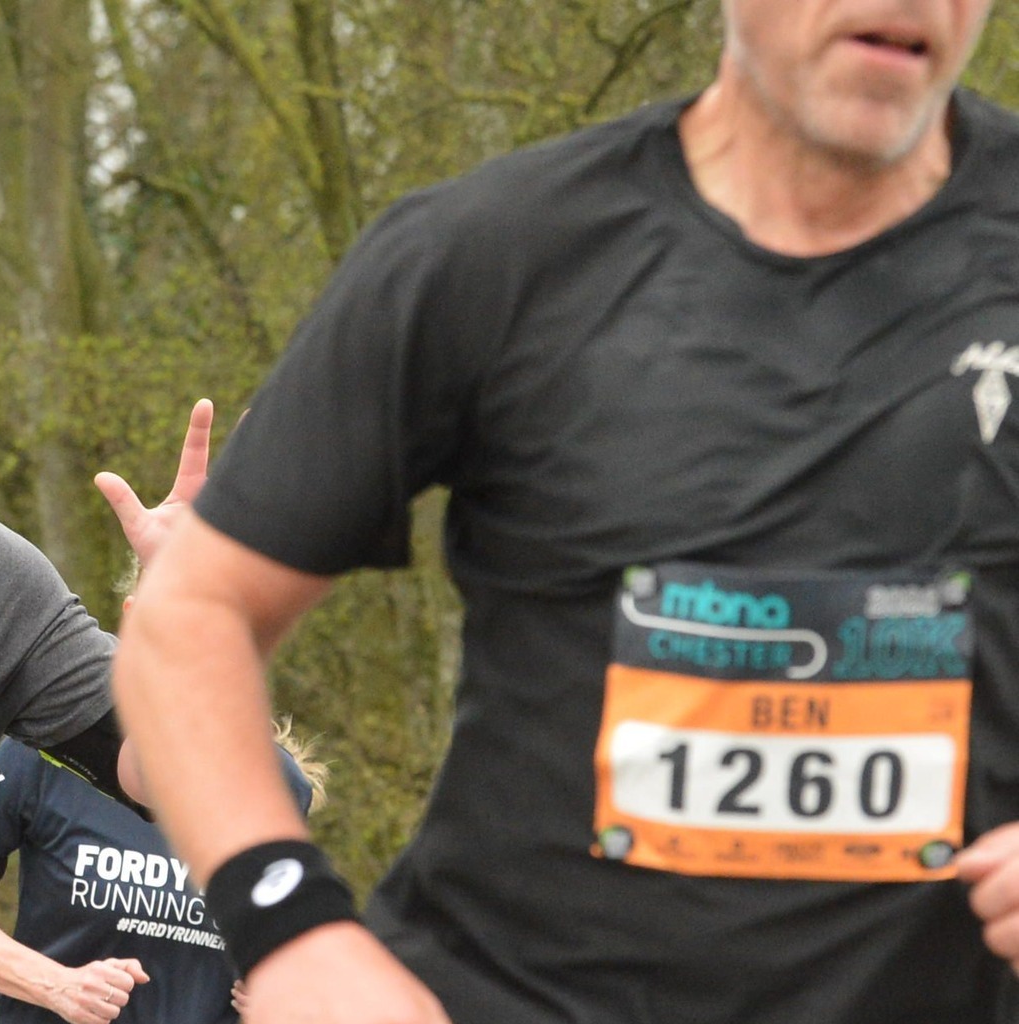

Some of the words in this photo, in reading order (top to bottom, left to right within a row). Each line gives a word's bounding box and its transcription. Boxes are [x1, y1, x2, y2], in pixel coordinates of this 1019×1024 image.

[661, 579, 791, 628] mbna
[751, 695, 830, 730] BEN
[658, 743, 905, 819] 1260
[74, 844, 190, 892] FORDY
[71, 878, 206, 925] RUNNING
